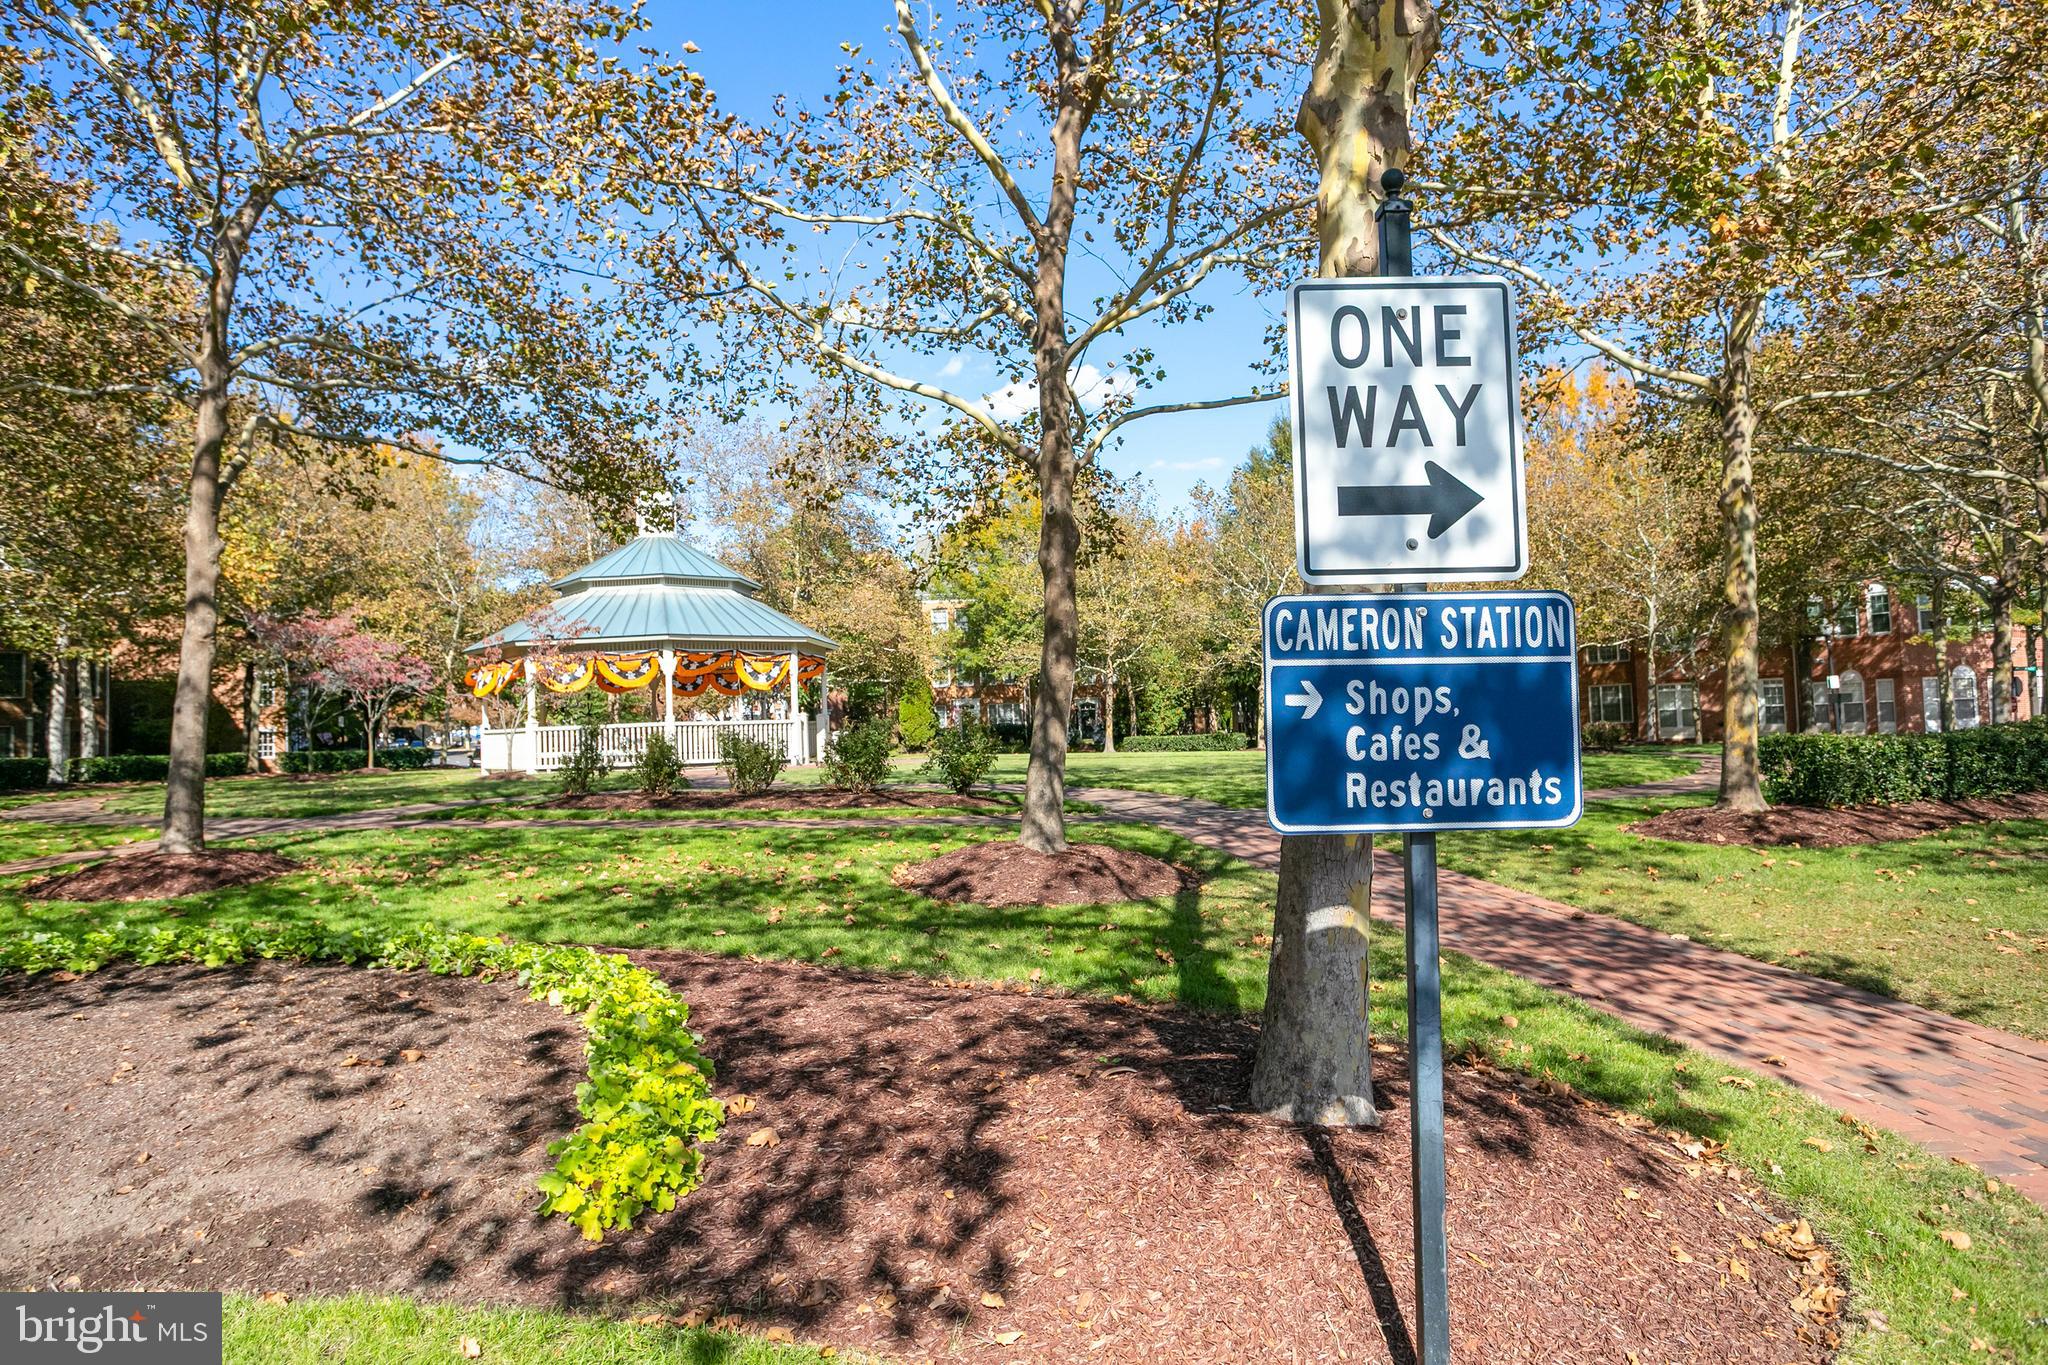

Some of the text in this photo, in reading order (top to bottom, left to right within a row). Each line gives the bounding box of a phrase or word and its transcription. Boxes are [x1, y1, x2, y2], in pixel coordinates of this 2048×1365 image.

[1329, 304, 1472, 369] ONE
[1326, 383, 1483, 449] WAY
[1275, 606, 1566, 653] CAMERON STATION
[1345, 679, 1460, 726] Shops,
[1345, 723, 1491, 763] Cafes &
[1345, 768, 1563, 810] Restaurants
